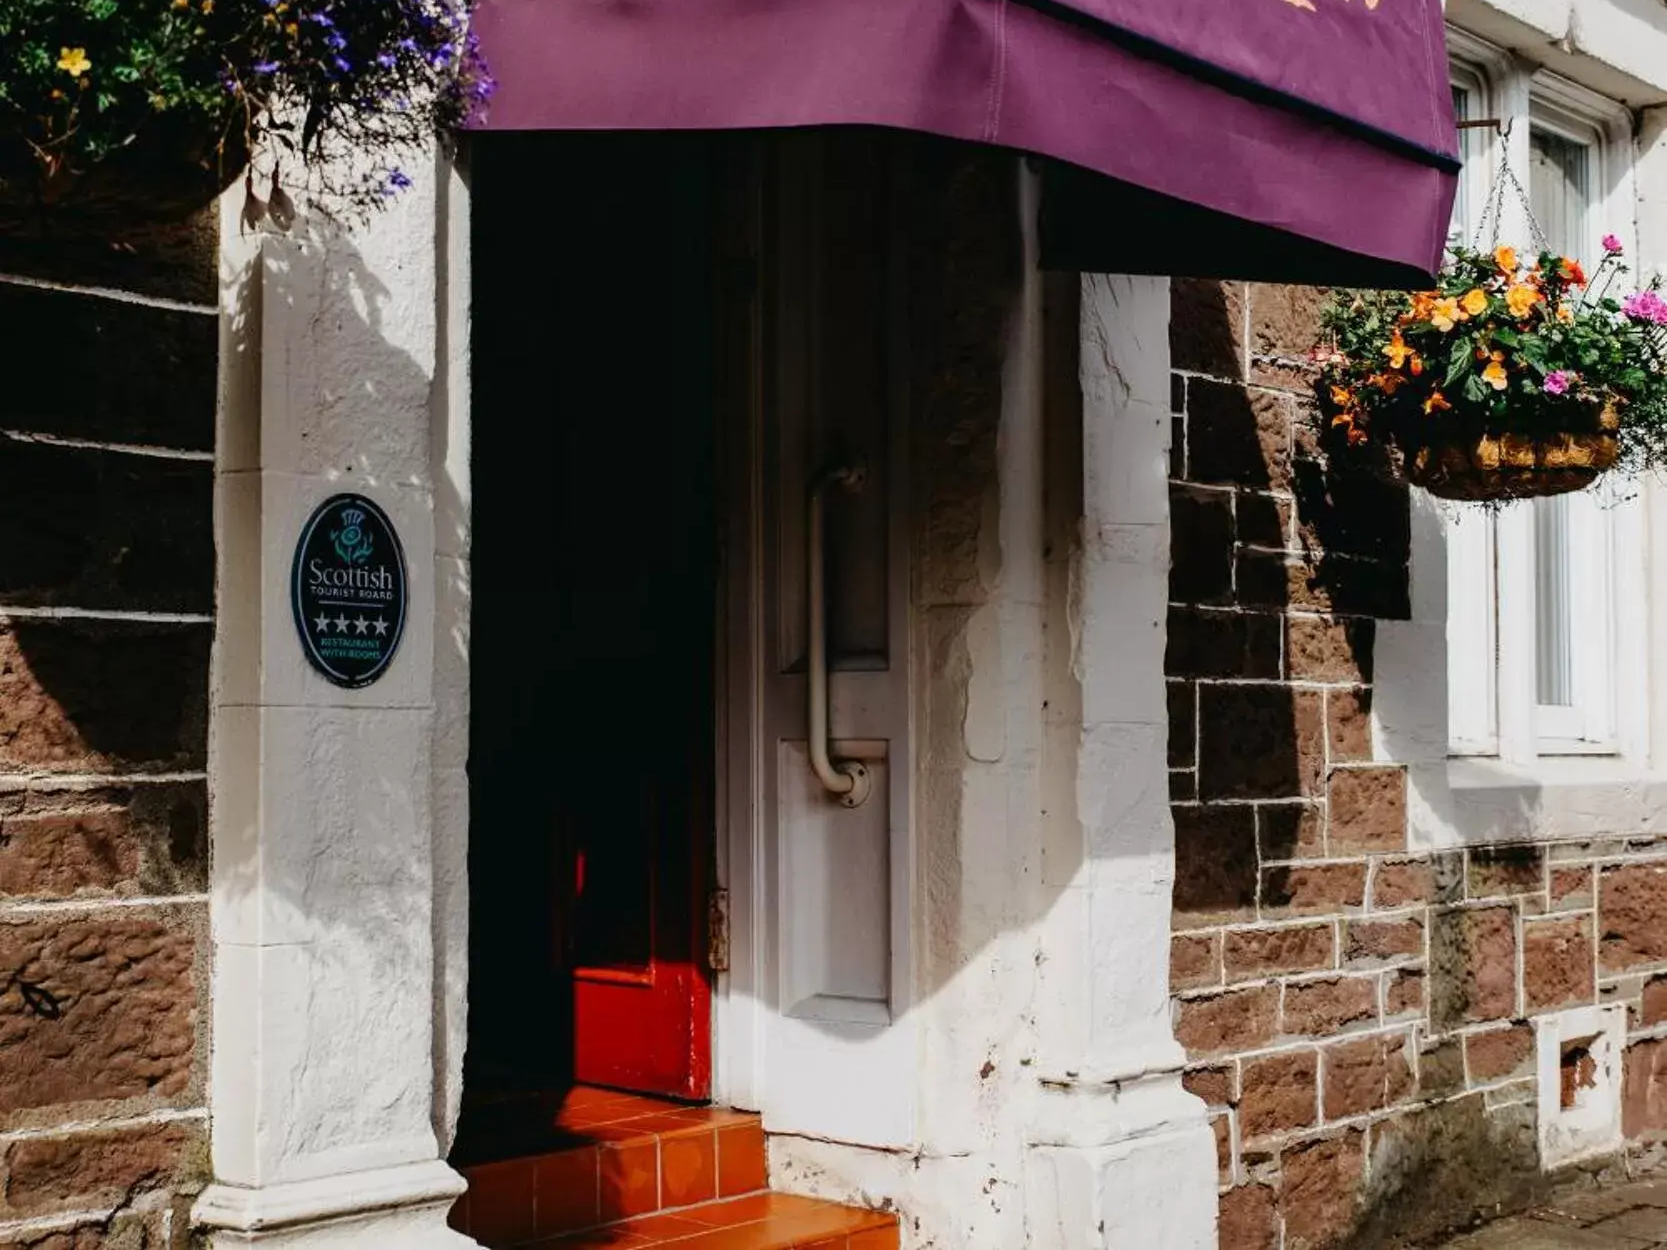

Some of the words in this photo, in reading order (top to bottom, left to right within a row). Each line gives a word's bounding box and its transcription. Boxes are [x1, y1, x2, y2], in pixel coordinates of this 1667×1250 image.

[309, 558, 393, 590] Scottish
[310, 585, 355, 598] TOURIST
[359, 590, 393, 601] BOARD
